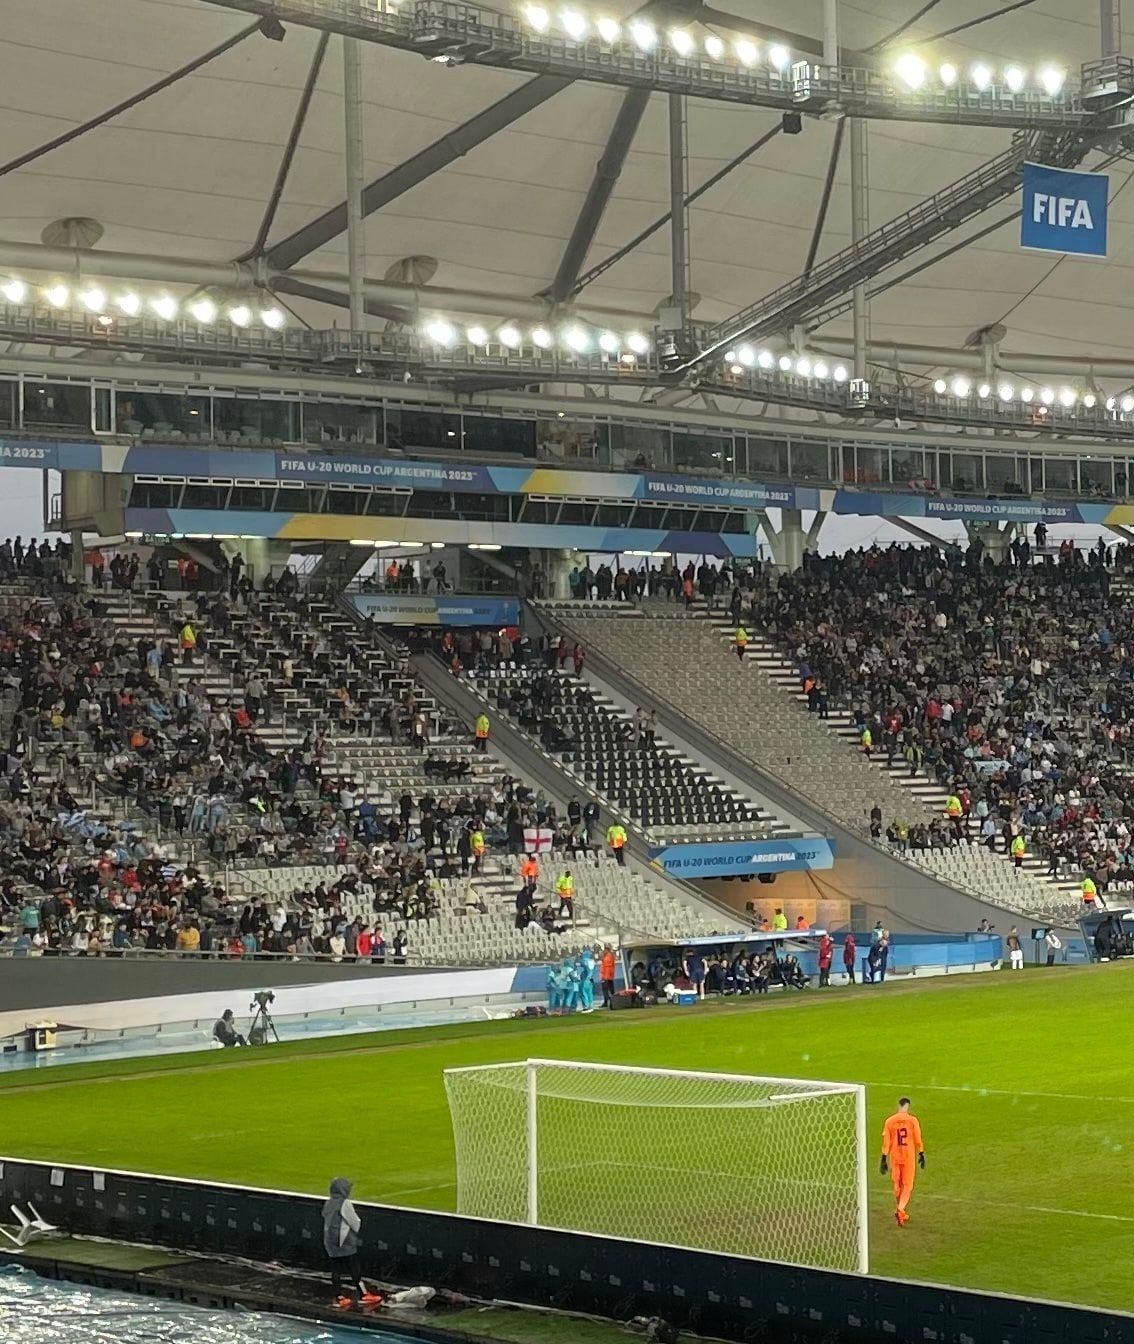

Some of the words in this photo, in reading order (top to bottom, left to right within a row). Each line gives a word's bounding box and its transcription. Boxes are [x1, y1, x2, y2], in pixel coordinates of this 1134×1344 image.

[1033, 192, 1094, 230] FIFA
[281, 460, 305, 471] FIFA
[307, 461, 331, 473] U-20
[333, 463, 371, 474] WORLD
[373, 465, 394, 476] CUP
[394, 467, 447, 479] ARGENTINA
[648, 482, 666, 492] FIFA
[667, 484, 685, 493] U-20
[685, 485, 713, 495] WORLD
[714, 487, 730, 497] CUP
[928, 502, 945, 512] FIFA
[946, 503, 963, 512] U-20
[964, 504, 991, 513] WORLD
[992, 505, 1007, 514] CUP
[663, 859, 682, 869] FIFA
[683, 858, 701, 868] U-20
[702, 856, 735, 866] WORLD
[736, 855, 751, 865] CUP
[751, 852, 796, 863] ARGENTINA
[896, 1127, 908, 1146] 12
